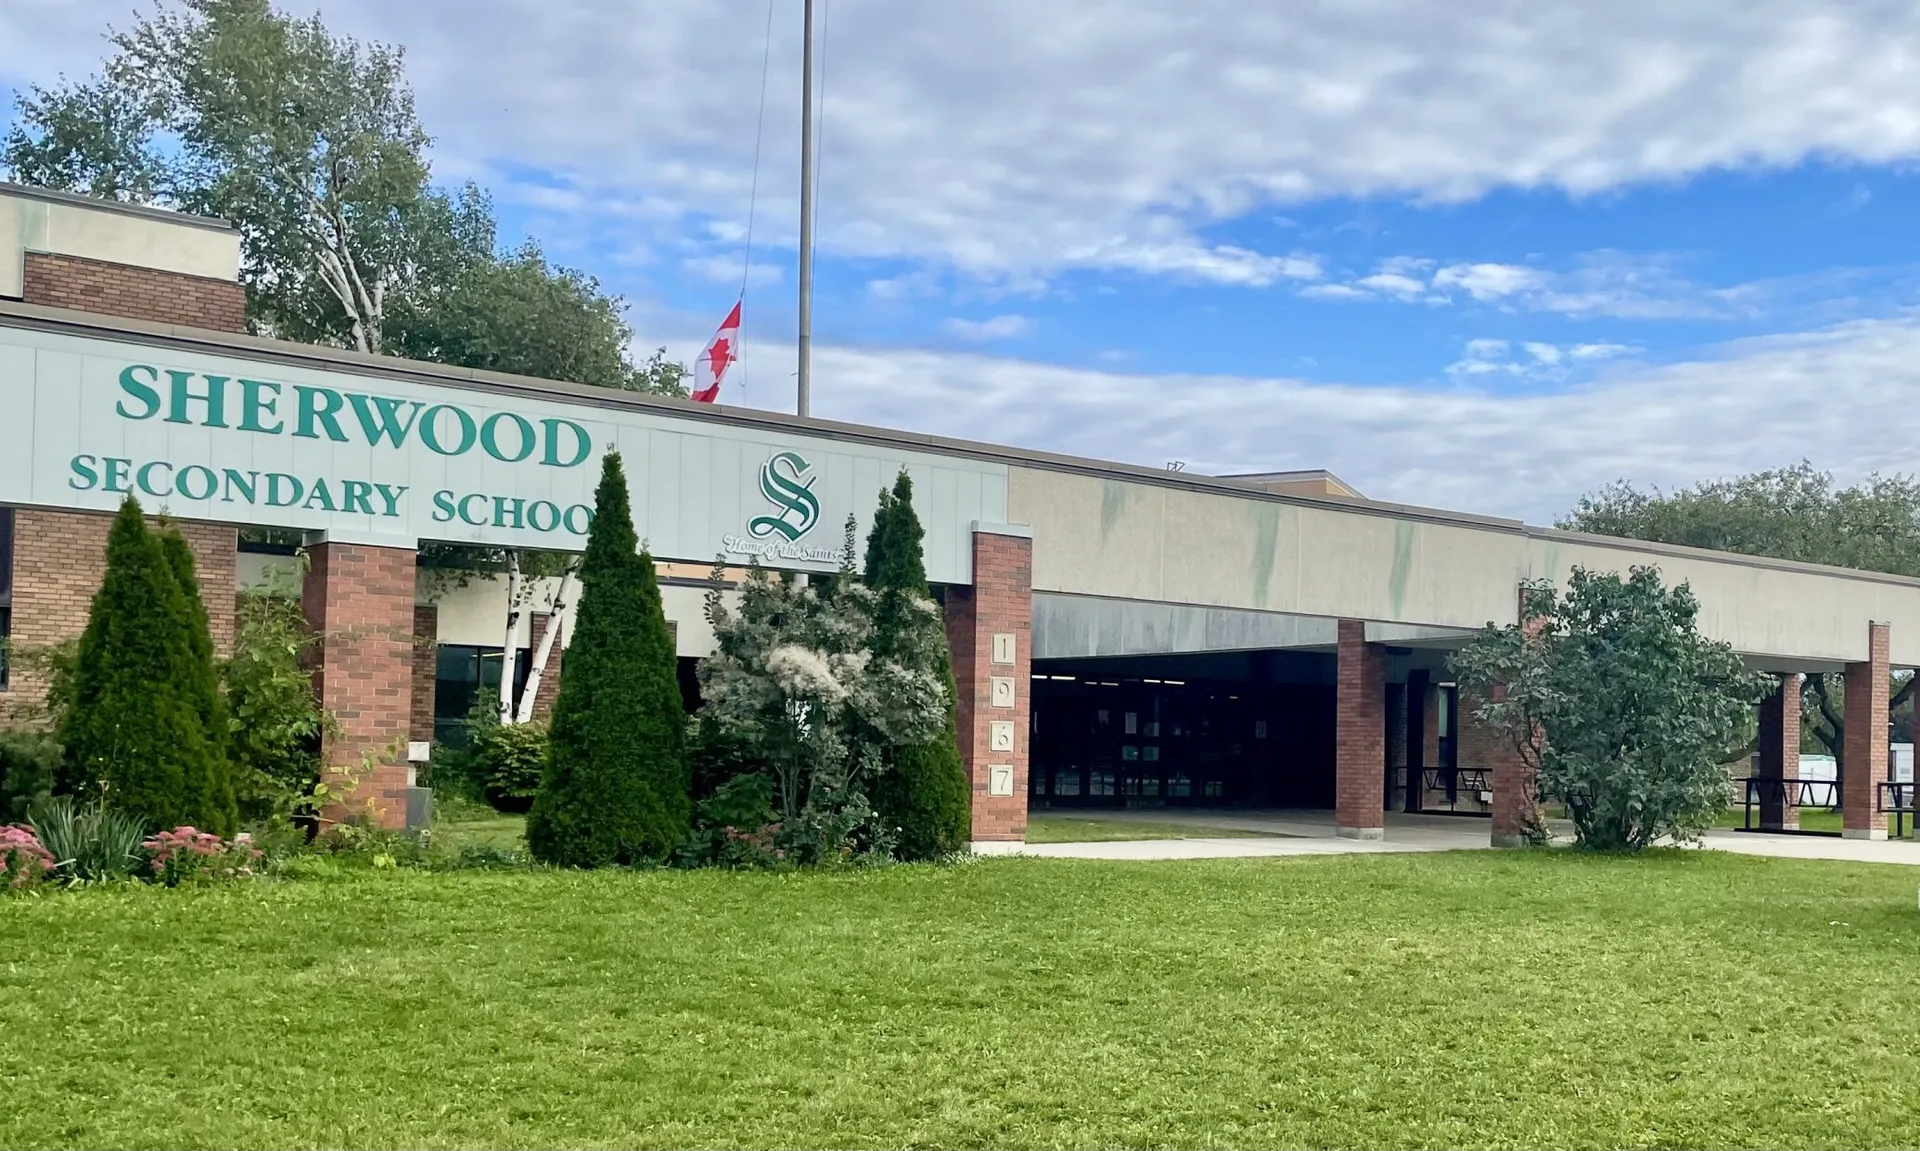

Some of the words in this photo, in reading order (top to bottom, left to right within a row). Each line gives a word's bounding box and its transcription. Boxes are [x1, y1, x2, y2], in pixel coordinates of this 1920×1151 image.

[116, 364, 592, 467] SHERWOOD
[68, 454, 410, 517] SECONDARY
[431, 489, 597, 536] SCHOO
[750, 452, 819, 541] S
[765, 541, 779, 558] of
[780, 540, 800, 557] the
